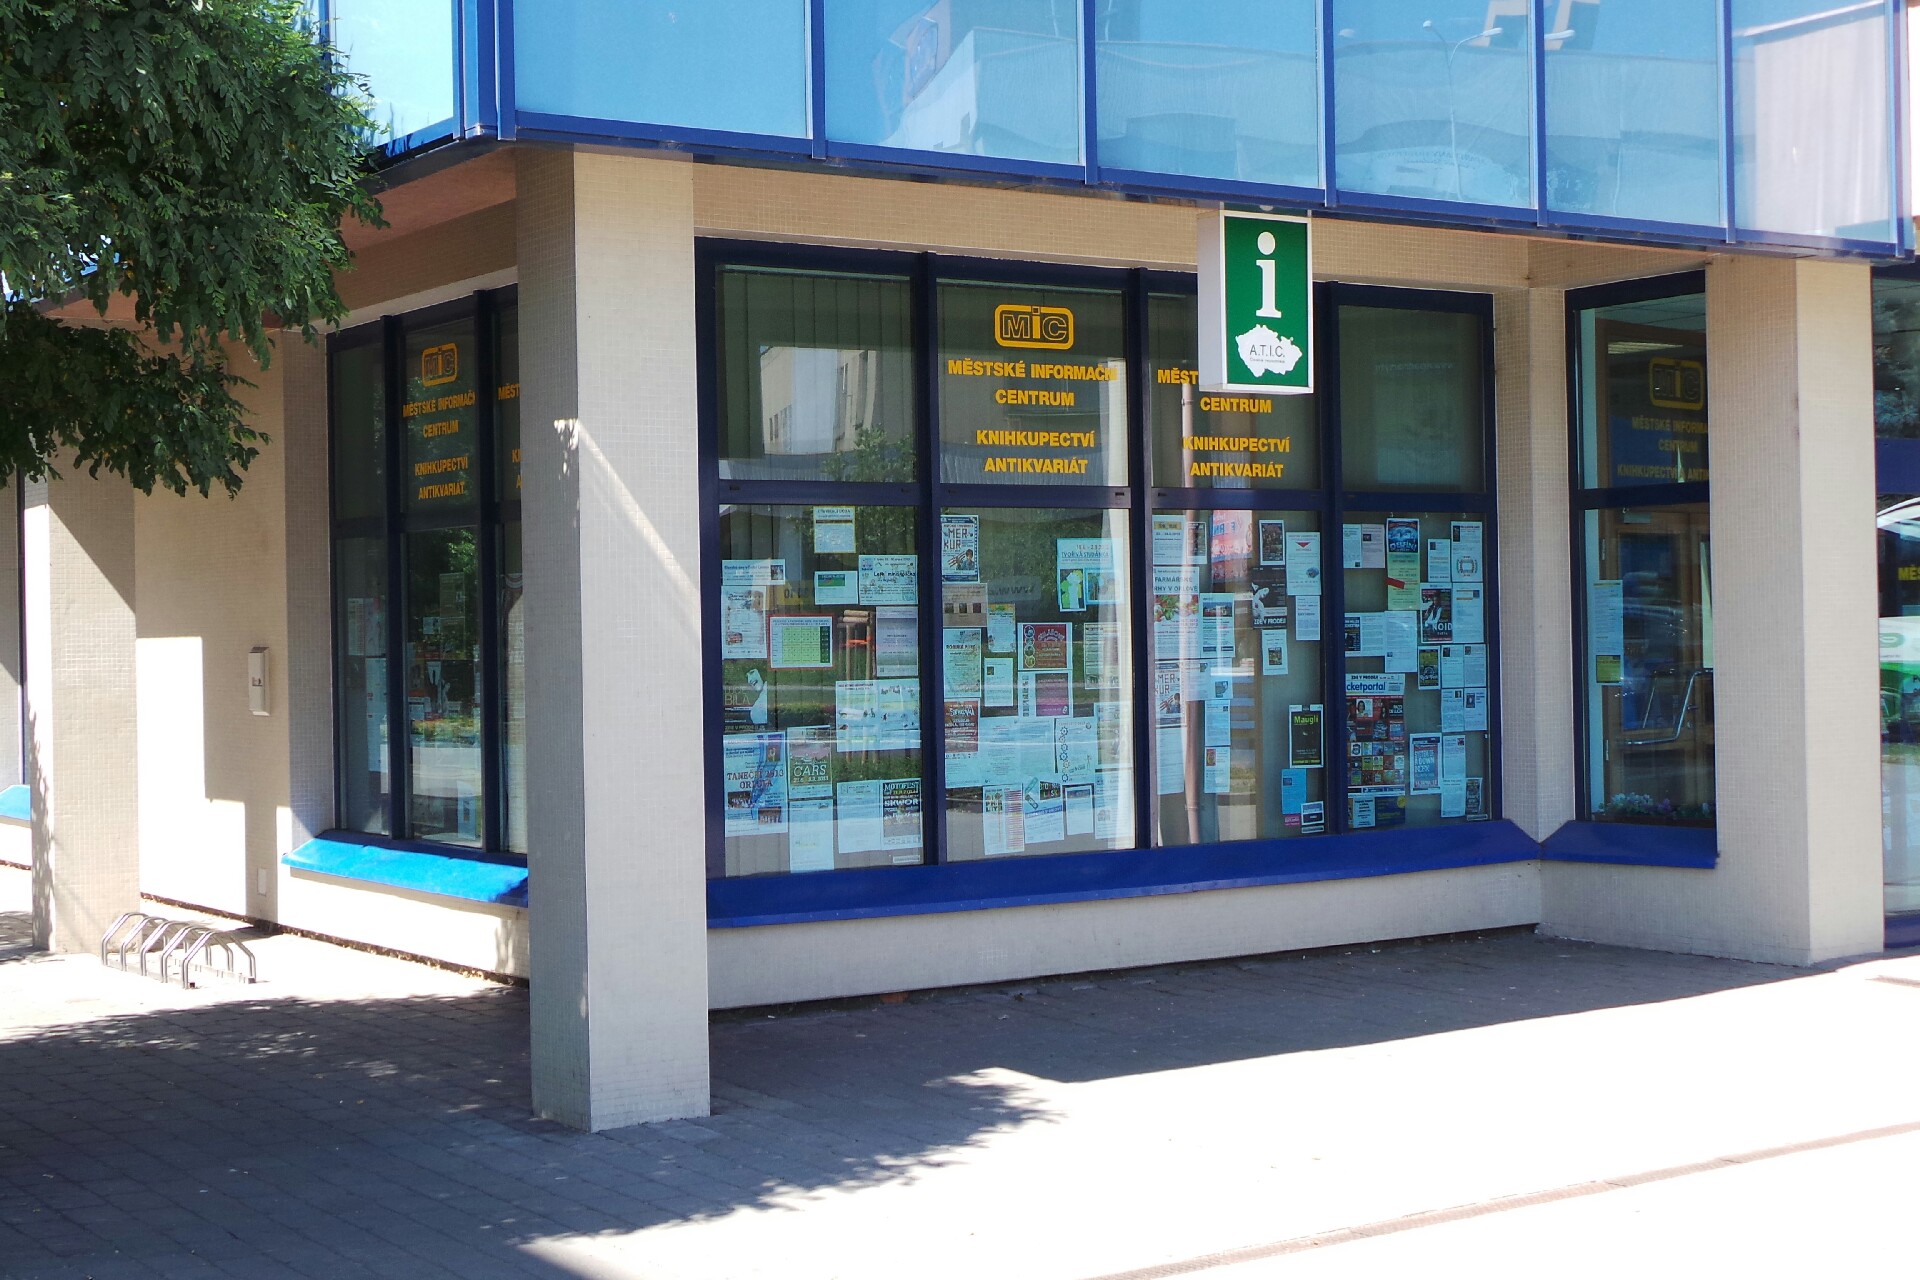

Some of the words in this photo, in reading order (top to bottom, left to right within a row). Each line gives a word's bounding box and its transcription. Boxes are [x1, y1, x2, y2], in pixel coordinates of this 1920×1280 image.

[1256, 232, 1282, 318] i
[1249, 344, 1286, 358] A.T.I.C.
[948, 358, 1025, 377] MĚSTSKÉ
[1031, 364, 1119, 381] INFORMAČNÍ
[1157, 368, 1199, 384] MĚST
[995, 389, 1075, 406] CENTRUM
[1200, 396, 1272, 413] CENTRUM
[403, 400, 436, 417] MĚSTSKÉ
[423, 420, 459, 438] CENTRUM
[977, 430, 1095, 447] KNIHKUPECTVÍ
[1182, 435, 1291, 452] KNIHKUPECTVÍ
[415, 454, 468, 476] KNIHKUPECTVÍ
[984, 457, 1088, 474] ANTIKVARIÁT
[1190, 462, 1284, 478] ANTIKVARIÁT
[1346, 681, 1386, 693] cketportal
[1294, 715, 1319, 725] Maugli
[793, 764, 827, 777] CARS
